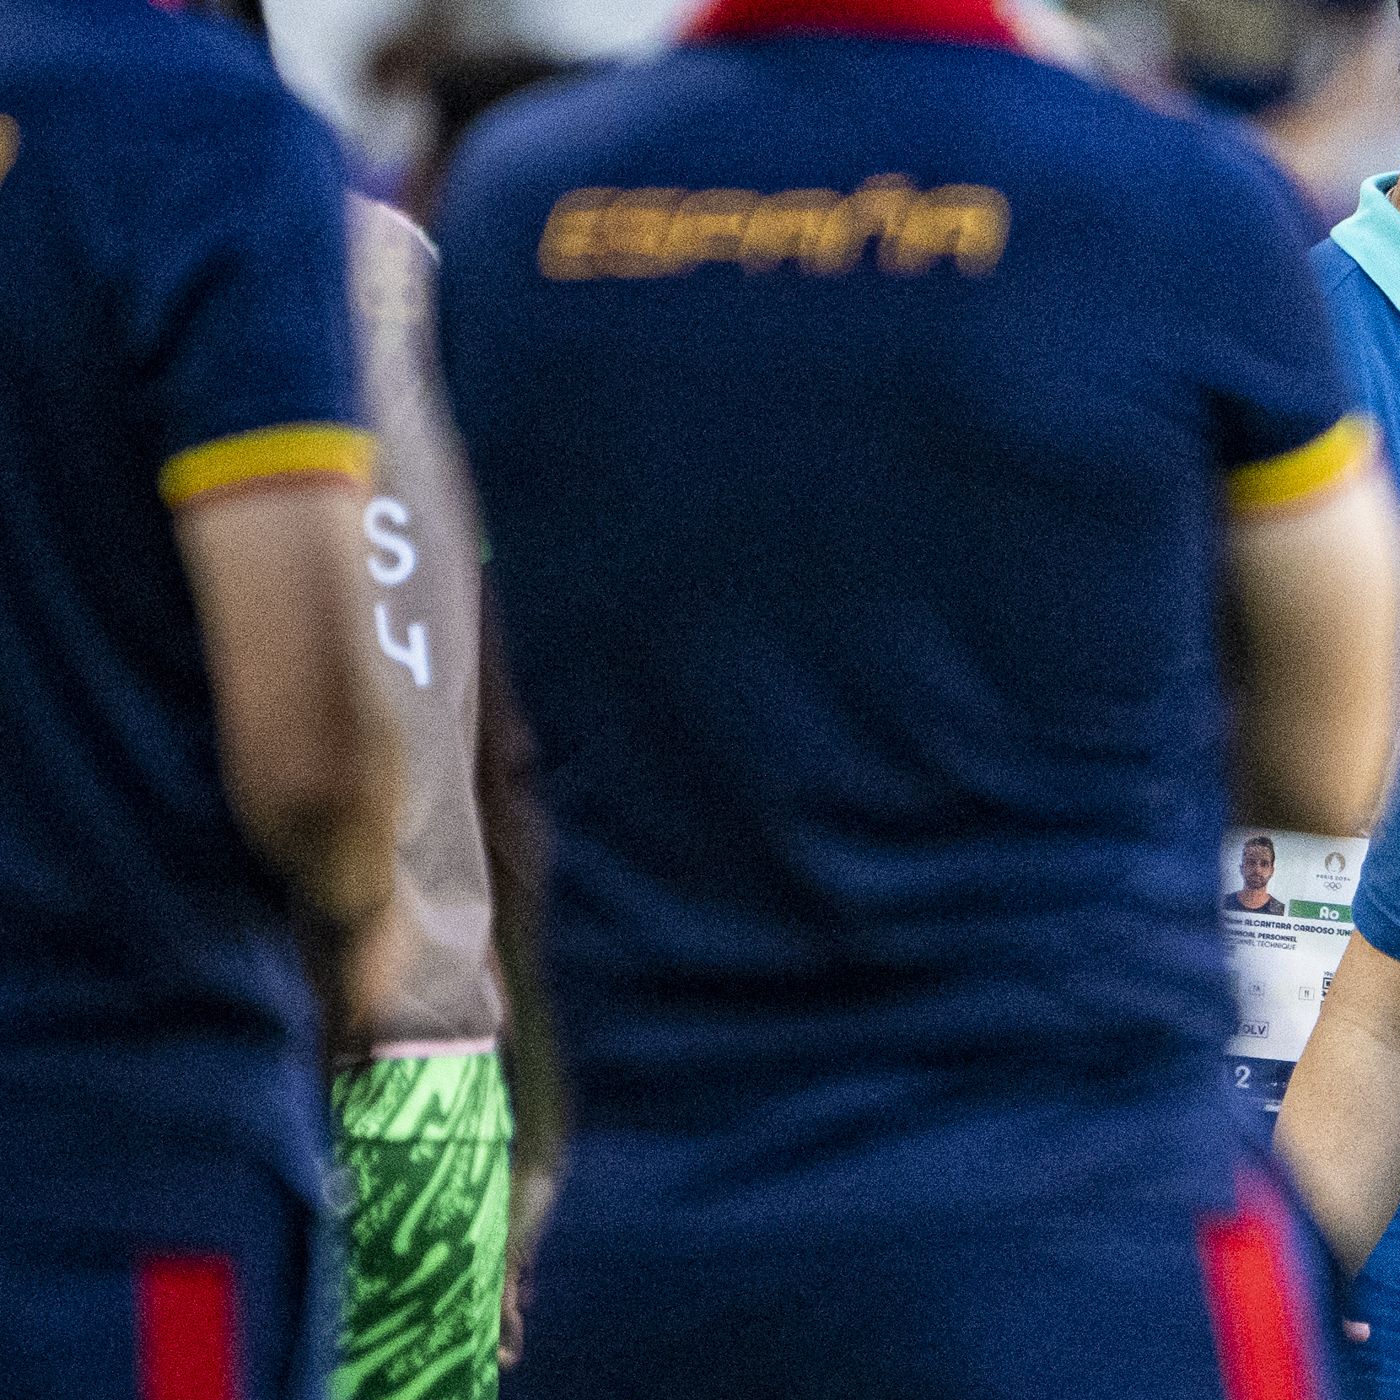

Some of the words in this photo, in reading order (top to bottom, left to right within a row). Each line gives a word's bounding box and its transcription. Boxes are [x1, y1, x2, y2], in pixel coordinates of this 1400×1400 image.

[1319, 906, 1339, 920] Ao
[1244, 919, 1292, 930] ALCANTARA
[1293, 924, 1335, 935] CARDOSO
[1258, 932, 1297, 943] PERSONNEL
[1257, 940, 1297, 951] TECHNIQUE
[1235, 1065, 1250, 1089] 2
